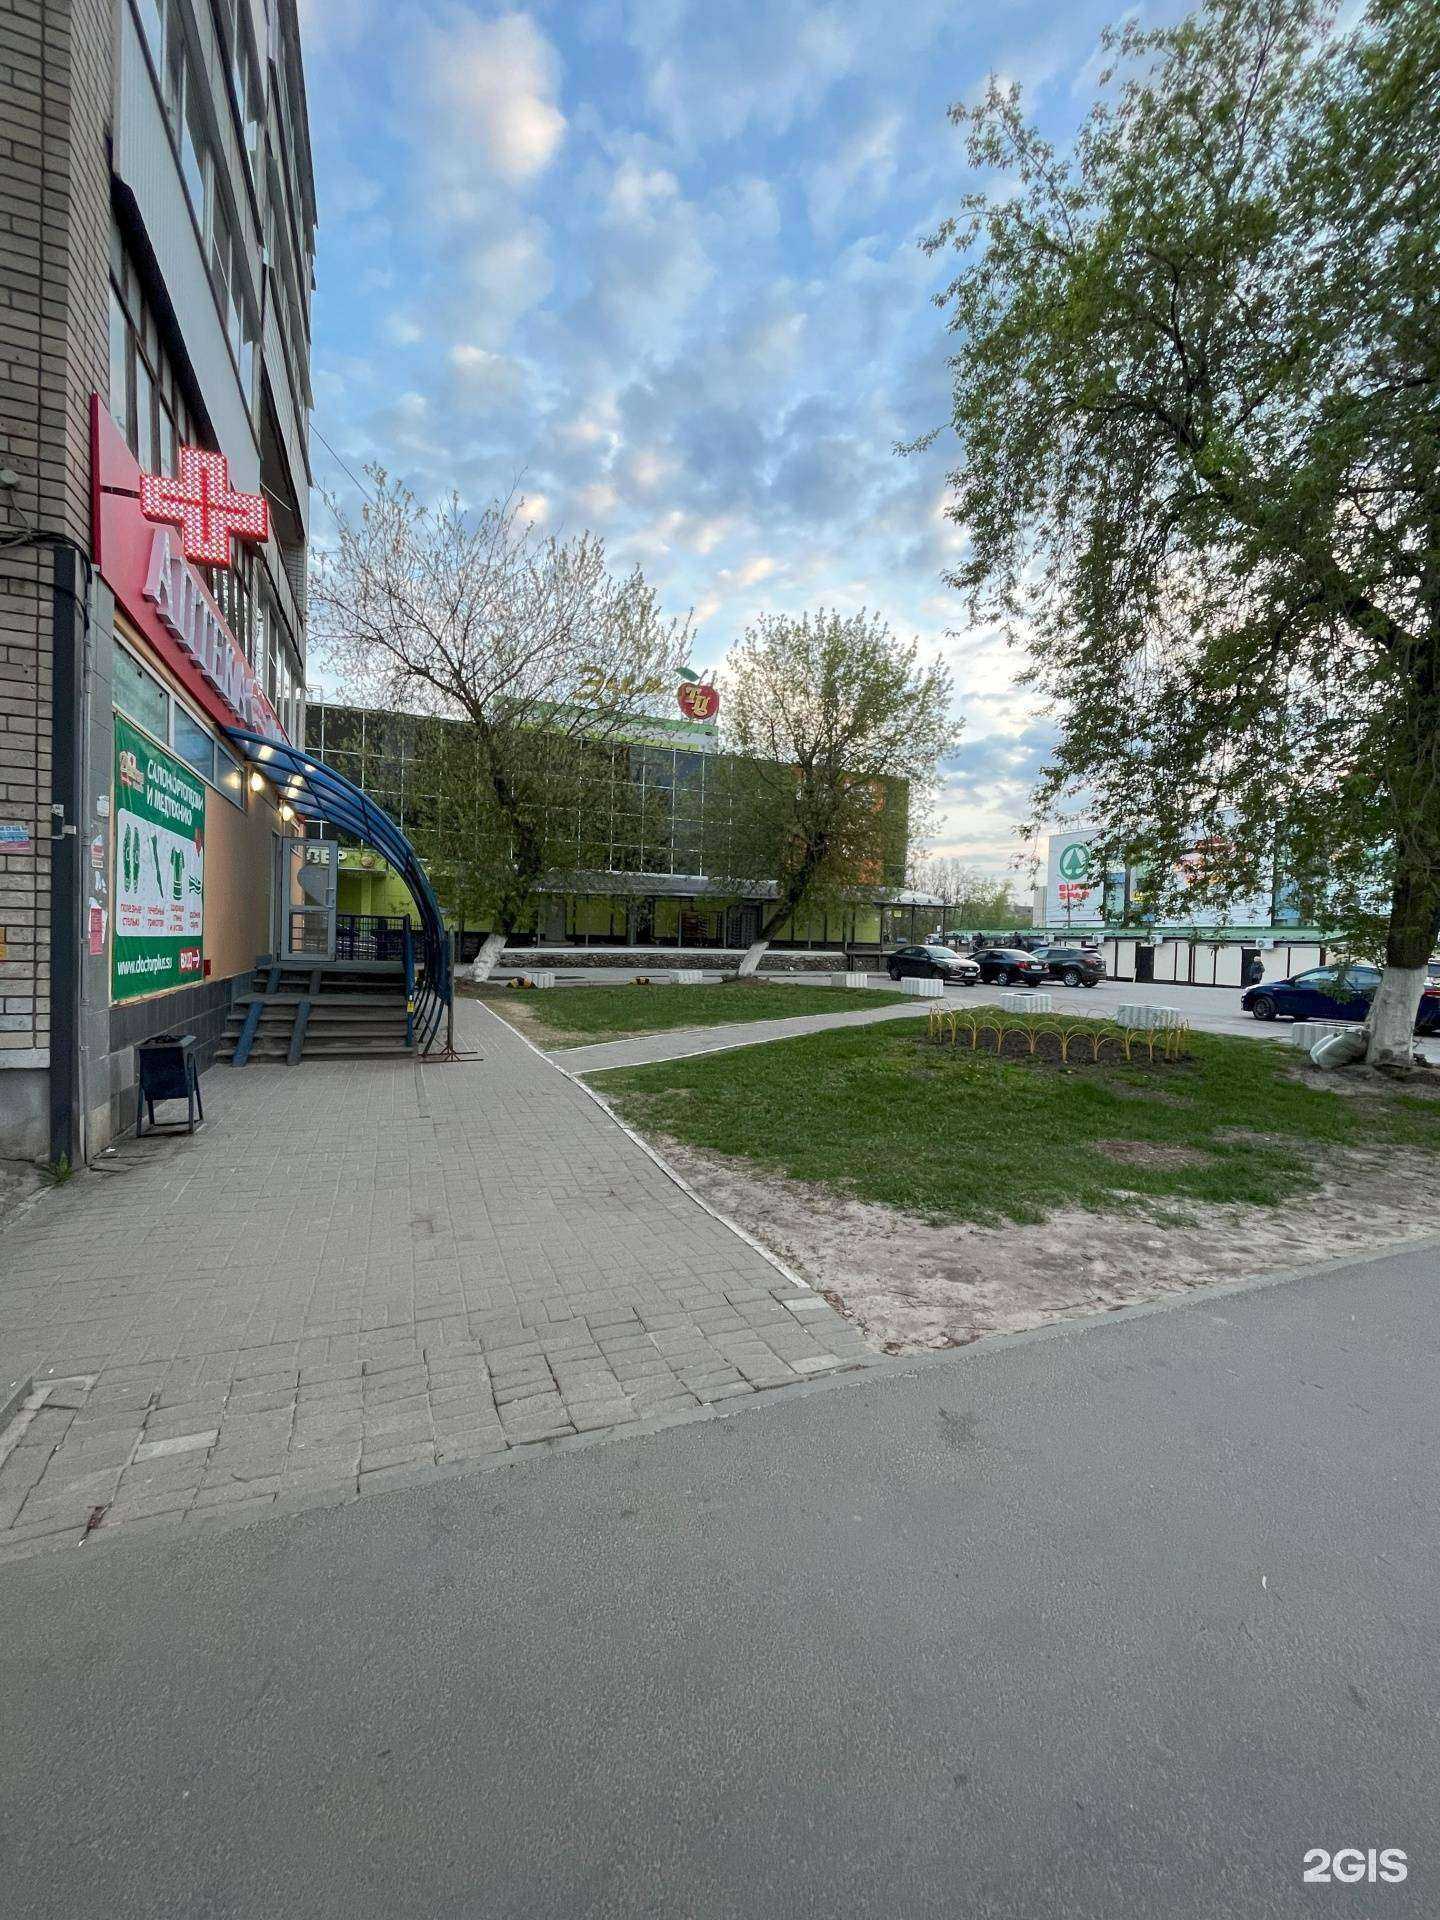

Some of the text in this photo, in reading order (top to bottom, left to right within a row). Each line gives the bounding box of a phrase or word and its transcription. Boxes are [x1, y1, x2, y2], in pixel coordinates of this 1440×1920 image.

[684, 686, 710, 717] ТЦ
[147, 759, 173, 791] САЛОН
[146, 785, 153, 807] И
